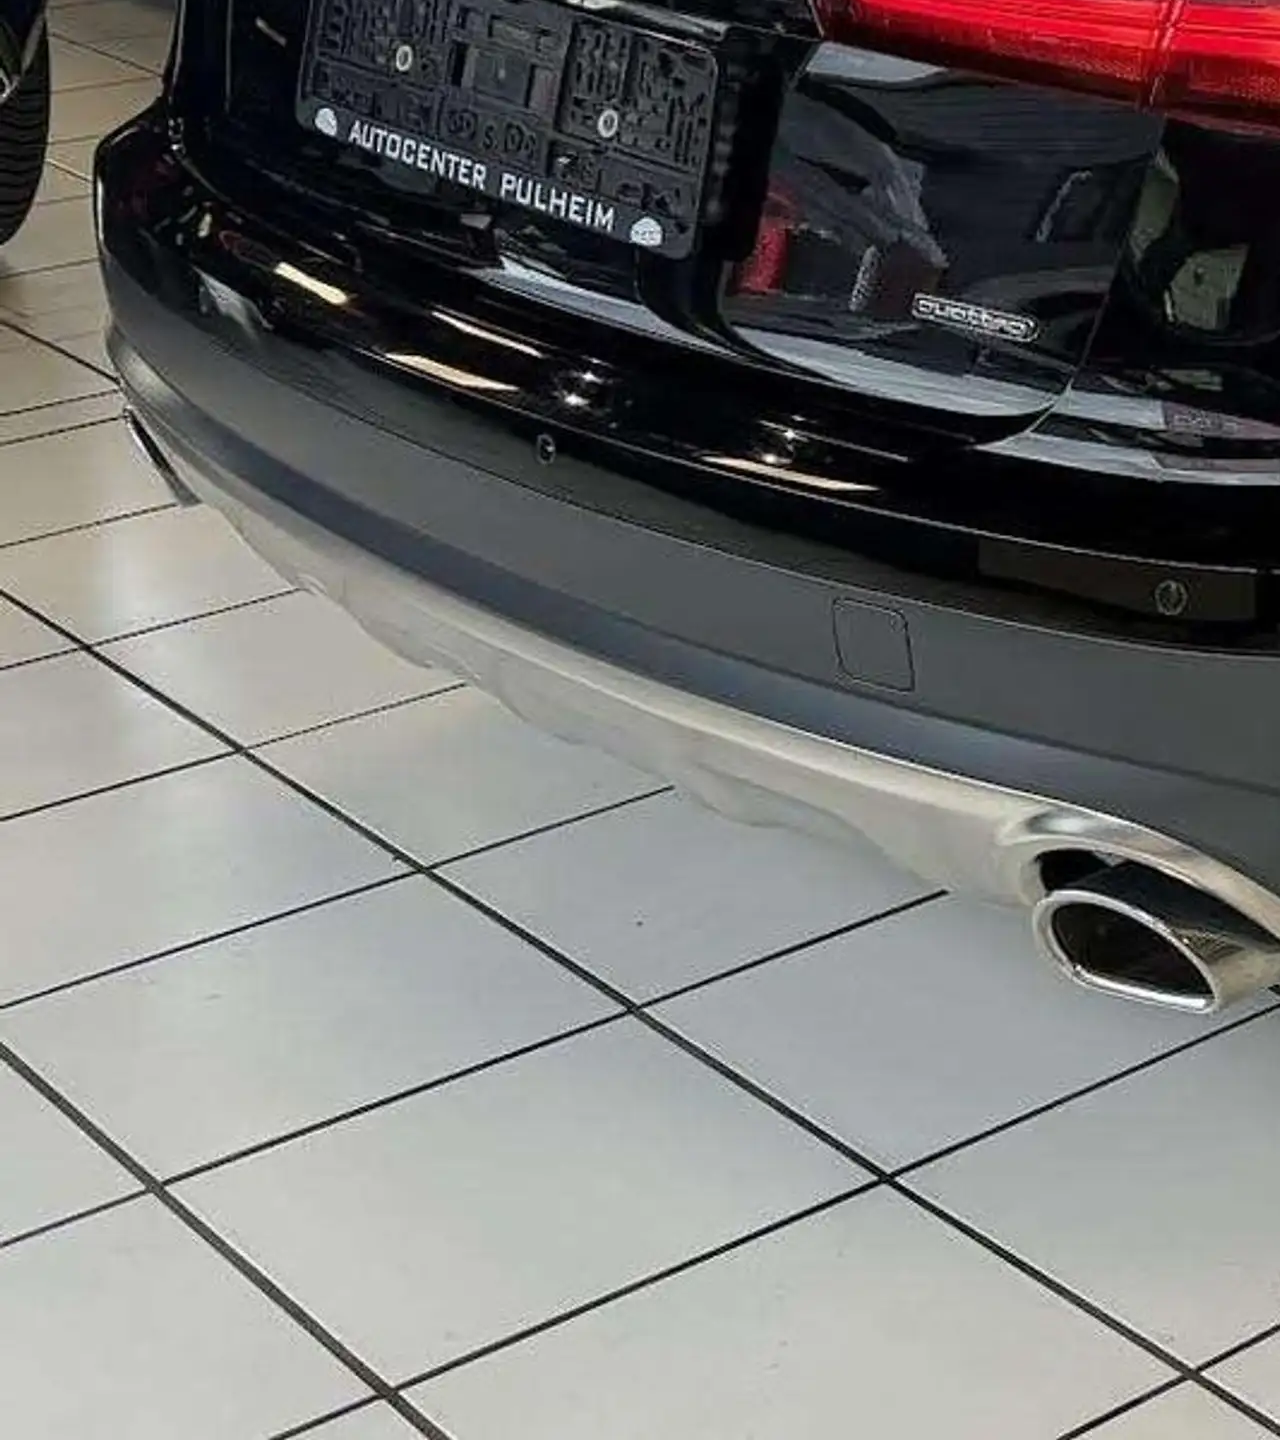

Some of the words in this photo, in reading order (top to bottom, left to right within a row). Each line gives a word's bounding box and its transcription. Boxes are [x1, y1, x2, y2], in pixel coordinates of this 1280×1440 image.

[349, 119, 487, 191] AUTOCENTER
[500, 172, 615, 233] PULHEIM
[917, 297, 1030, 338] quattro
